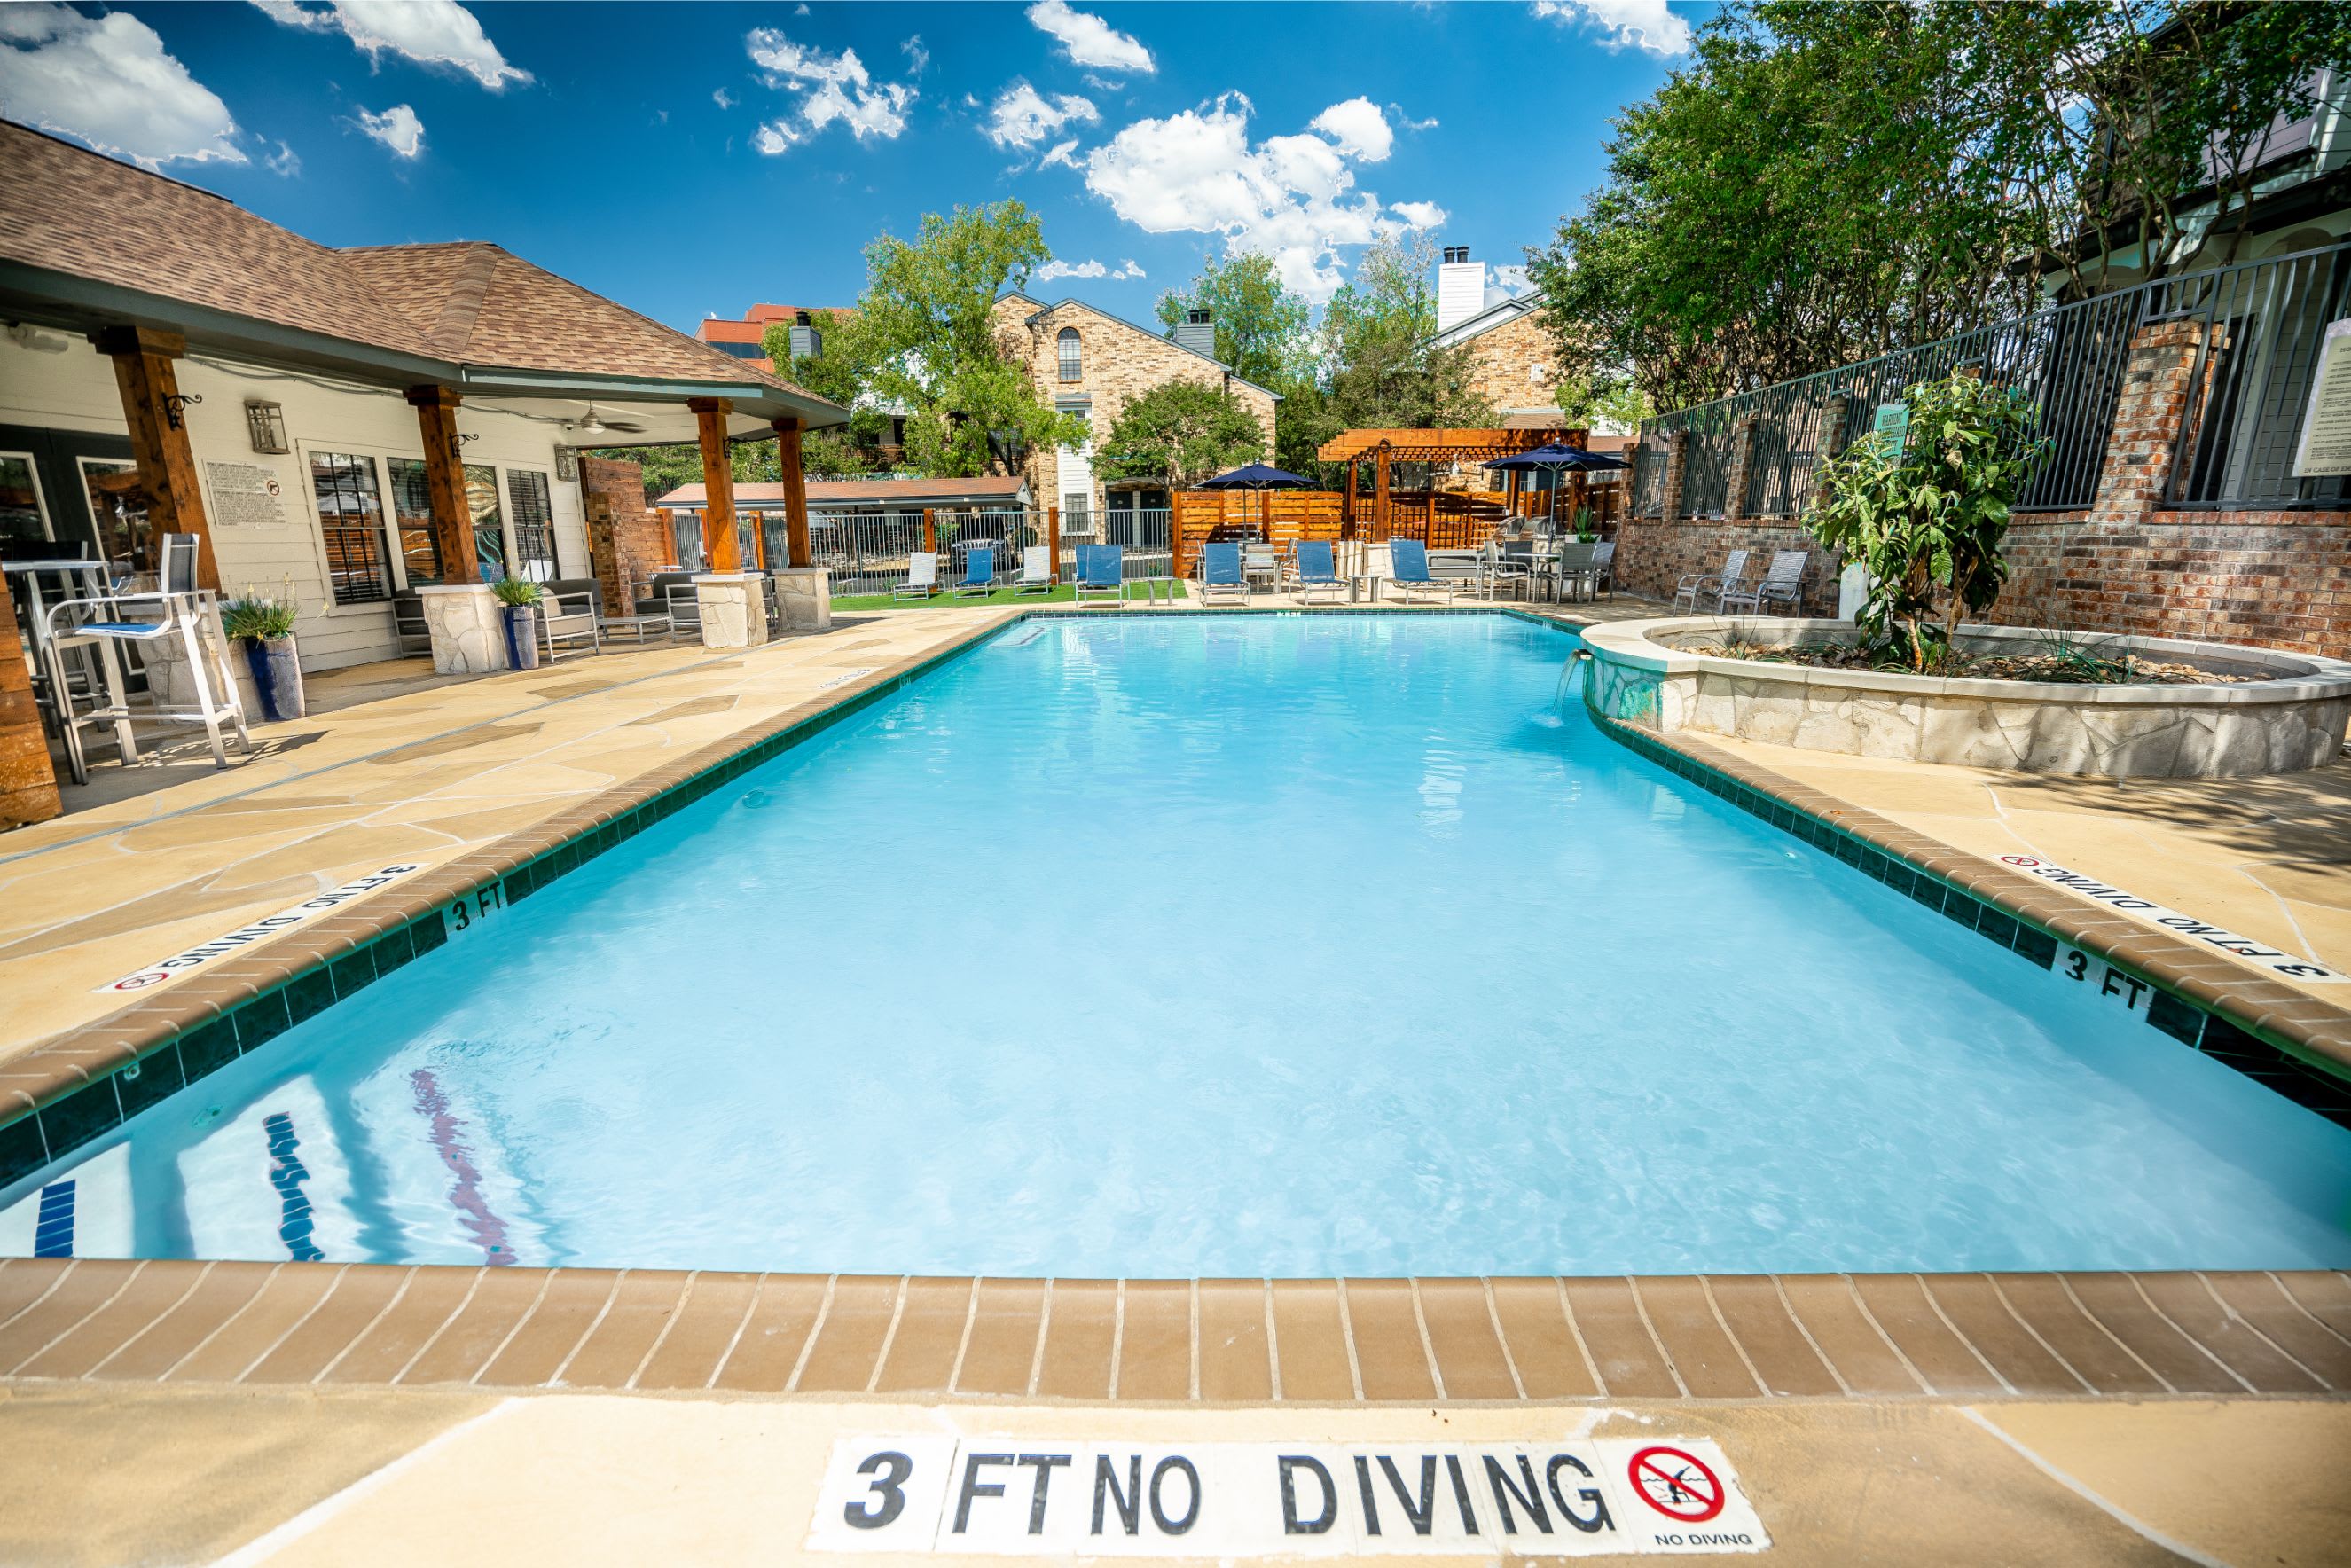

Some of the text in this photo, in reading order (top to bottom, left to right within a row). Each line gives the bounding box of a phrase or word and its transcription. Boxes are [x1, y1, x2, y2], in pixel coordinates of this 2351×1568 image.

[302, 892, 358, 908] NO
[341, 877, 393, 890] FT
[452, 881, 500, 931] 3 FT
[156, 916, 302, 968] DIVING
[2032, 868, 2330, 976] 3 FT NO DIVING
[2064, 950, 2148, 1010] 3 FT
[843, 1450, 1617, 1536] 3 FT NO DIVING
[1654, 1533, 1753, 1545] NO DIVING
